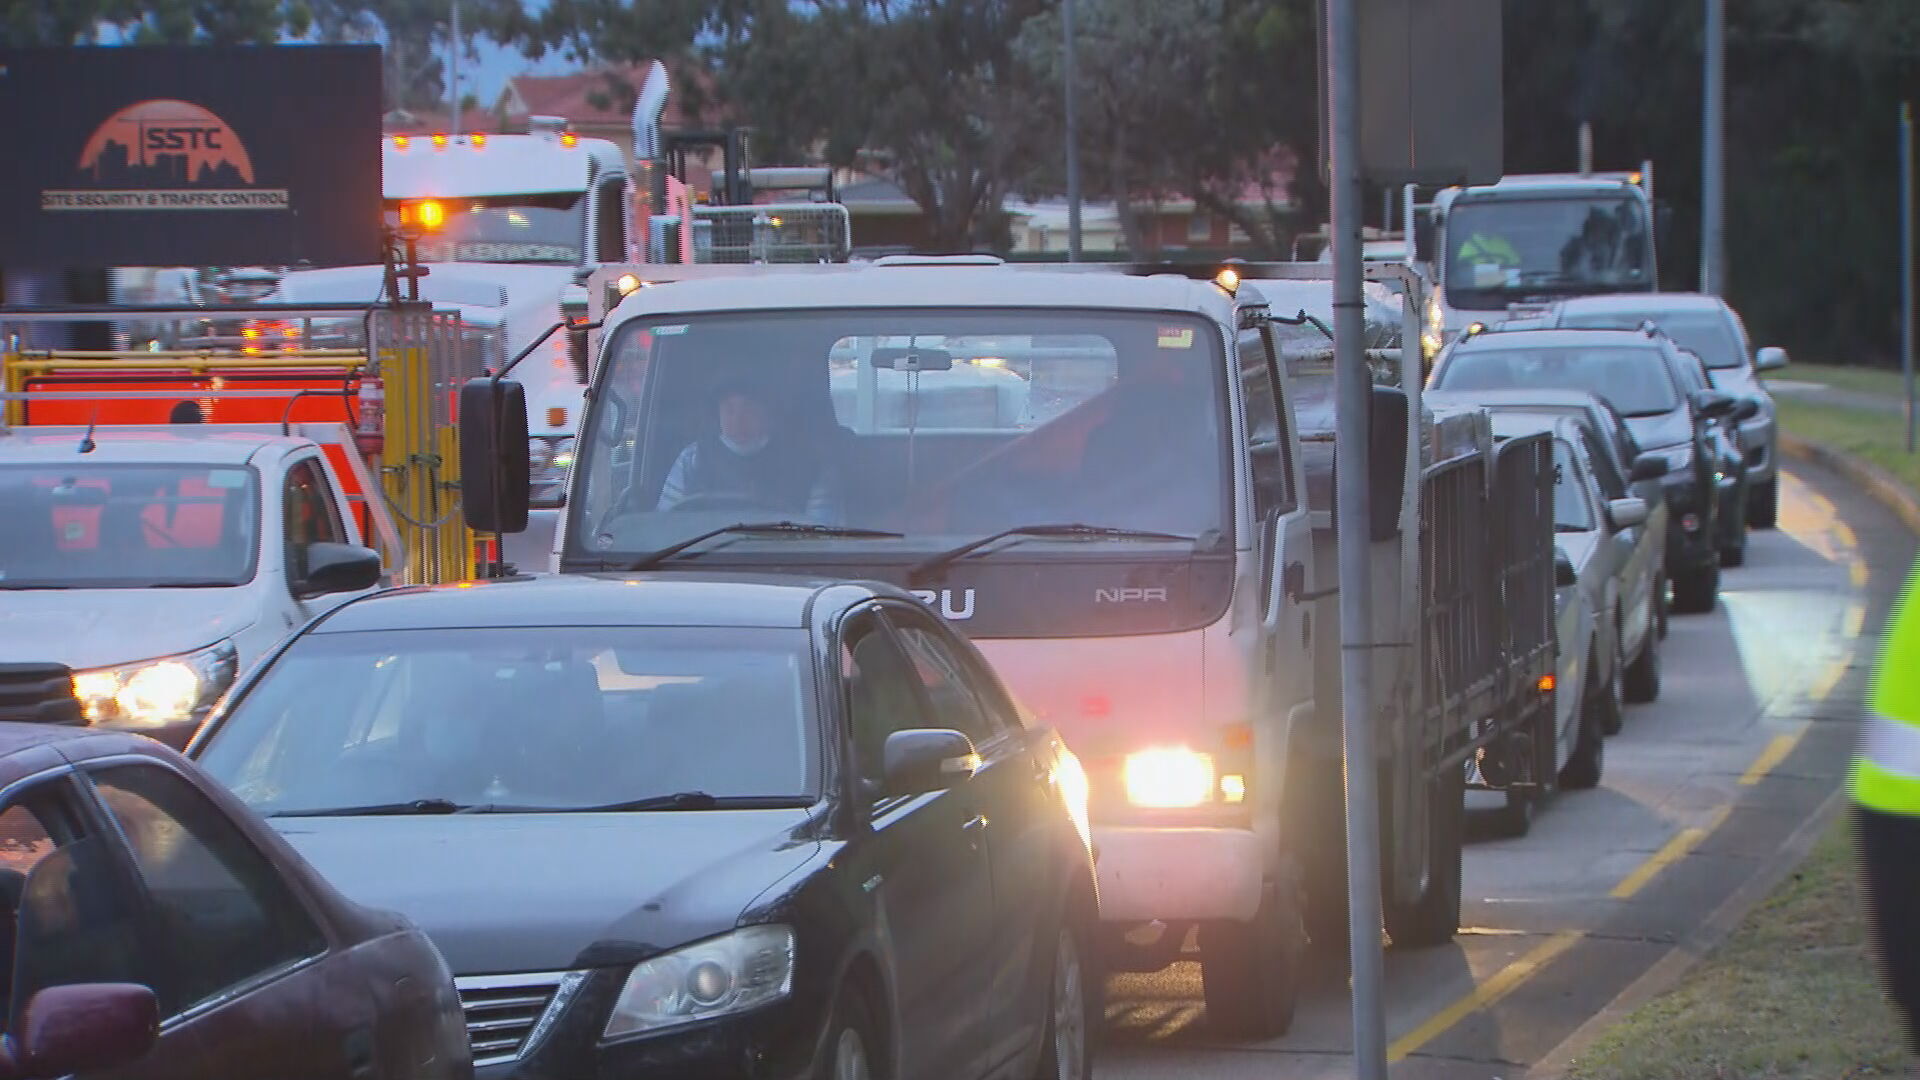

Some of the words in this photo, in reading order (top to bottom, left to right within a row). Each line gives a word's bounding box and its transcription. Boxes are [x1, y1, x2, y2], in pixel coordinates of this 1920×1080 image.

[146, 127, 221, 149] SSTC
[42, 192, 74, 206] SITE
[76, 192, 142, 206] SECURITY
[147, 192, 157, 206] &
[160, 192, 217, 206] TRAFFIC
[219, 192, 288, 206] CONTROL
[1095, 587, 1168, 602] NPR
